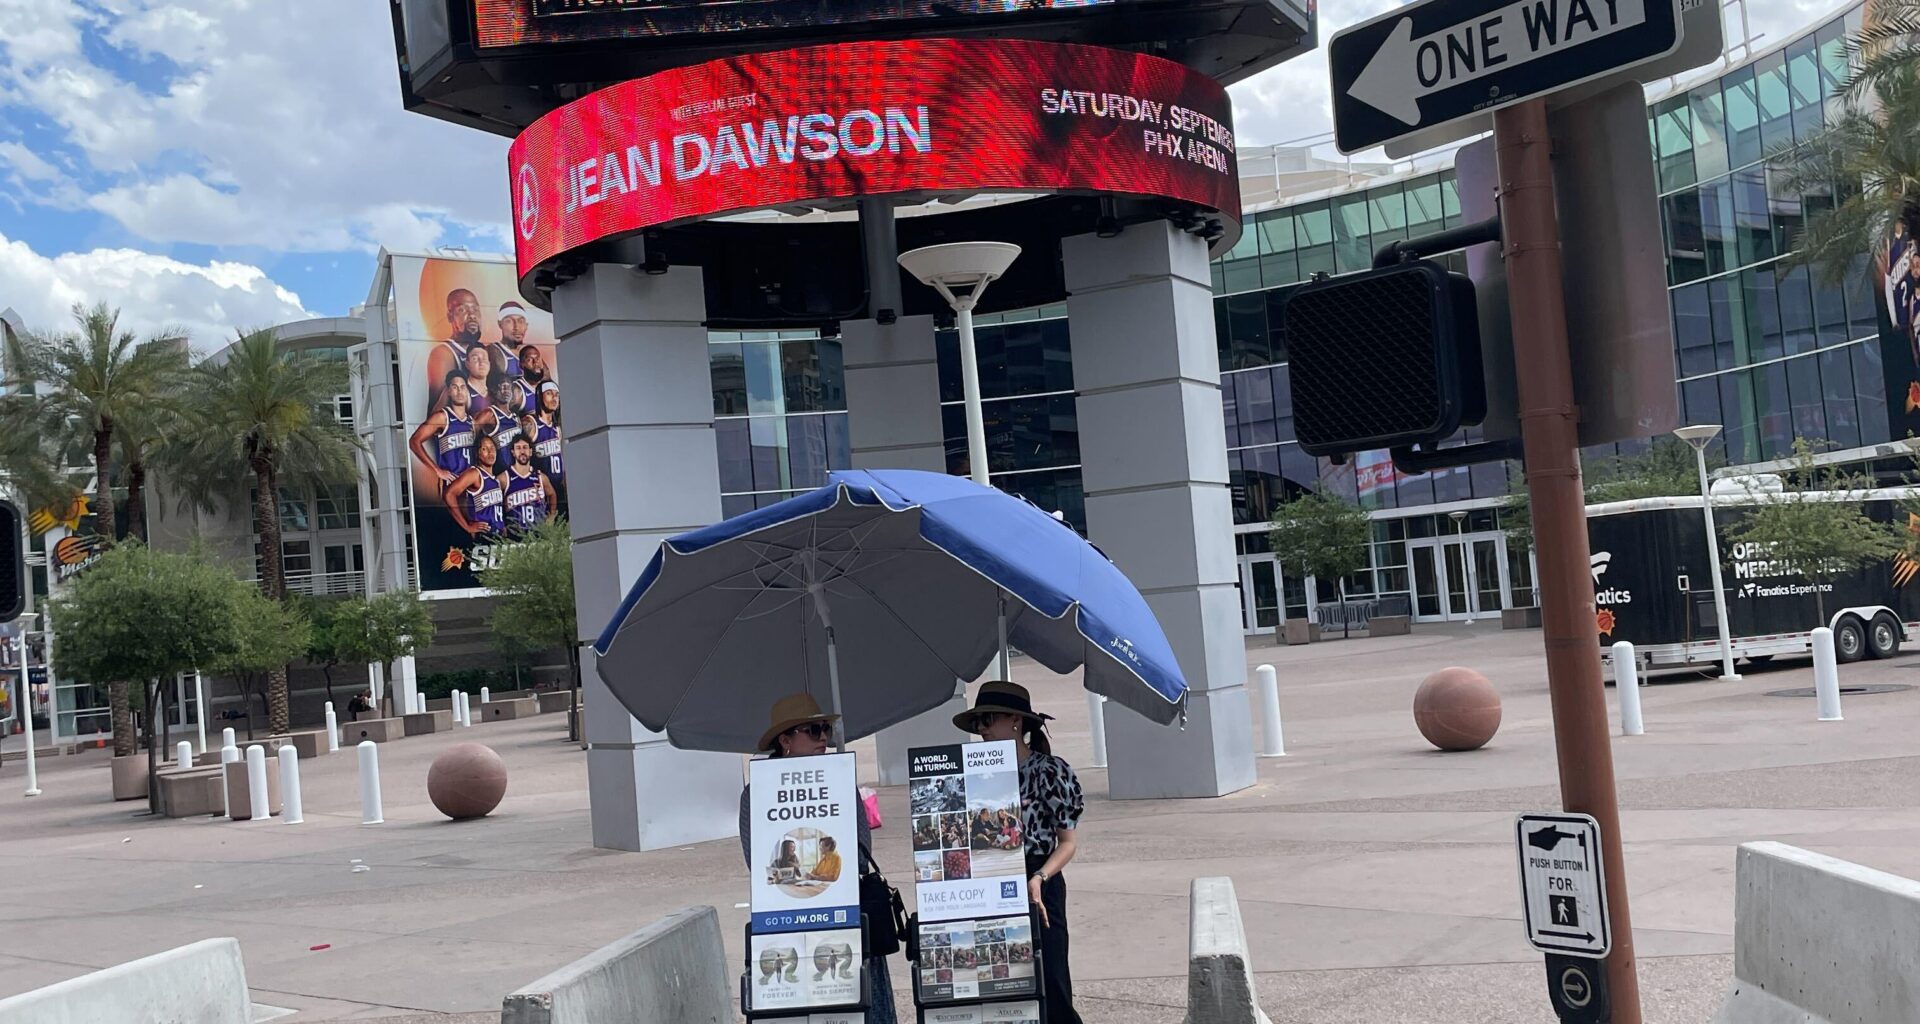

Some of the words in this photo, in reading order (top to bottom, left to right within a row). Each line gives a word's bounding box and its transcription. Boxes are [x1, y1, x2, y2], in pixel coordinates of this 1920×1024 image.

[1417, 15, 1508, 88] ONE
[1041, 88, 1169, 130] SATURDAY,
[565, 140, 662, 213] JEAN
[673, 106, 933, 181] DAWSON
[1144, 130, 1185, 160] PHX
[1187, 138, 1229, 175] ARENA
[447, 433, 475, 449] SUNS
[462, 448, 470, 465] 4
[551, 455, 560, 474] 10
[481, 489, 503, 507] SUNS
[506, 488, 537, 509] SUNS
[494, 505, 503, 522] 14
[522, 505, 535, 523] 18
[1738, 589, 1746, 598] A
[1757, 585, 1789, 597] Fanatics
[1790, 583, 1833, 596] Experince
[920, 754, 948, 763] WORLD
[967, 751, 985, 759] HOW
[987, 749, 1003, 758] YOU
[914, 764, 923, 773] IN
[924, 762, 958, 771] TURMOIL
[967, 760, 984, 768] CAN
[984, 757, 1005, 766] COPE
[780, 770, 825, 785] FREE
[777, 787, 829, 803] BIBLE
[767, 804, 840, 821] COURSE
[1530, 857, 1551, 869] PUSH
[1553, 859, 1583, 871] BUTTON
[1004, 883, 1015, 891] JW
[1548, 876, 1573, 891] FOR
[922, 891, 946, 904] TAKE
[949, 890, 956, 901] A
[959, 888, 985, 900] COPY
[765, 917, 778, 926] GO
[781, 916, 792, 925] TO
[794, 913, 829, 924] JW.ORG
